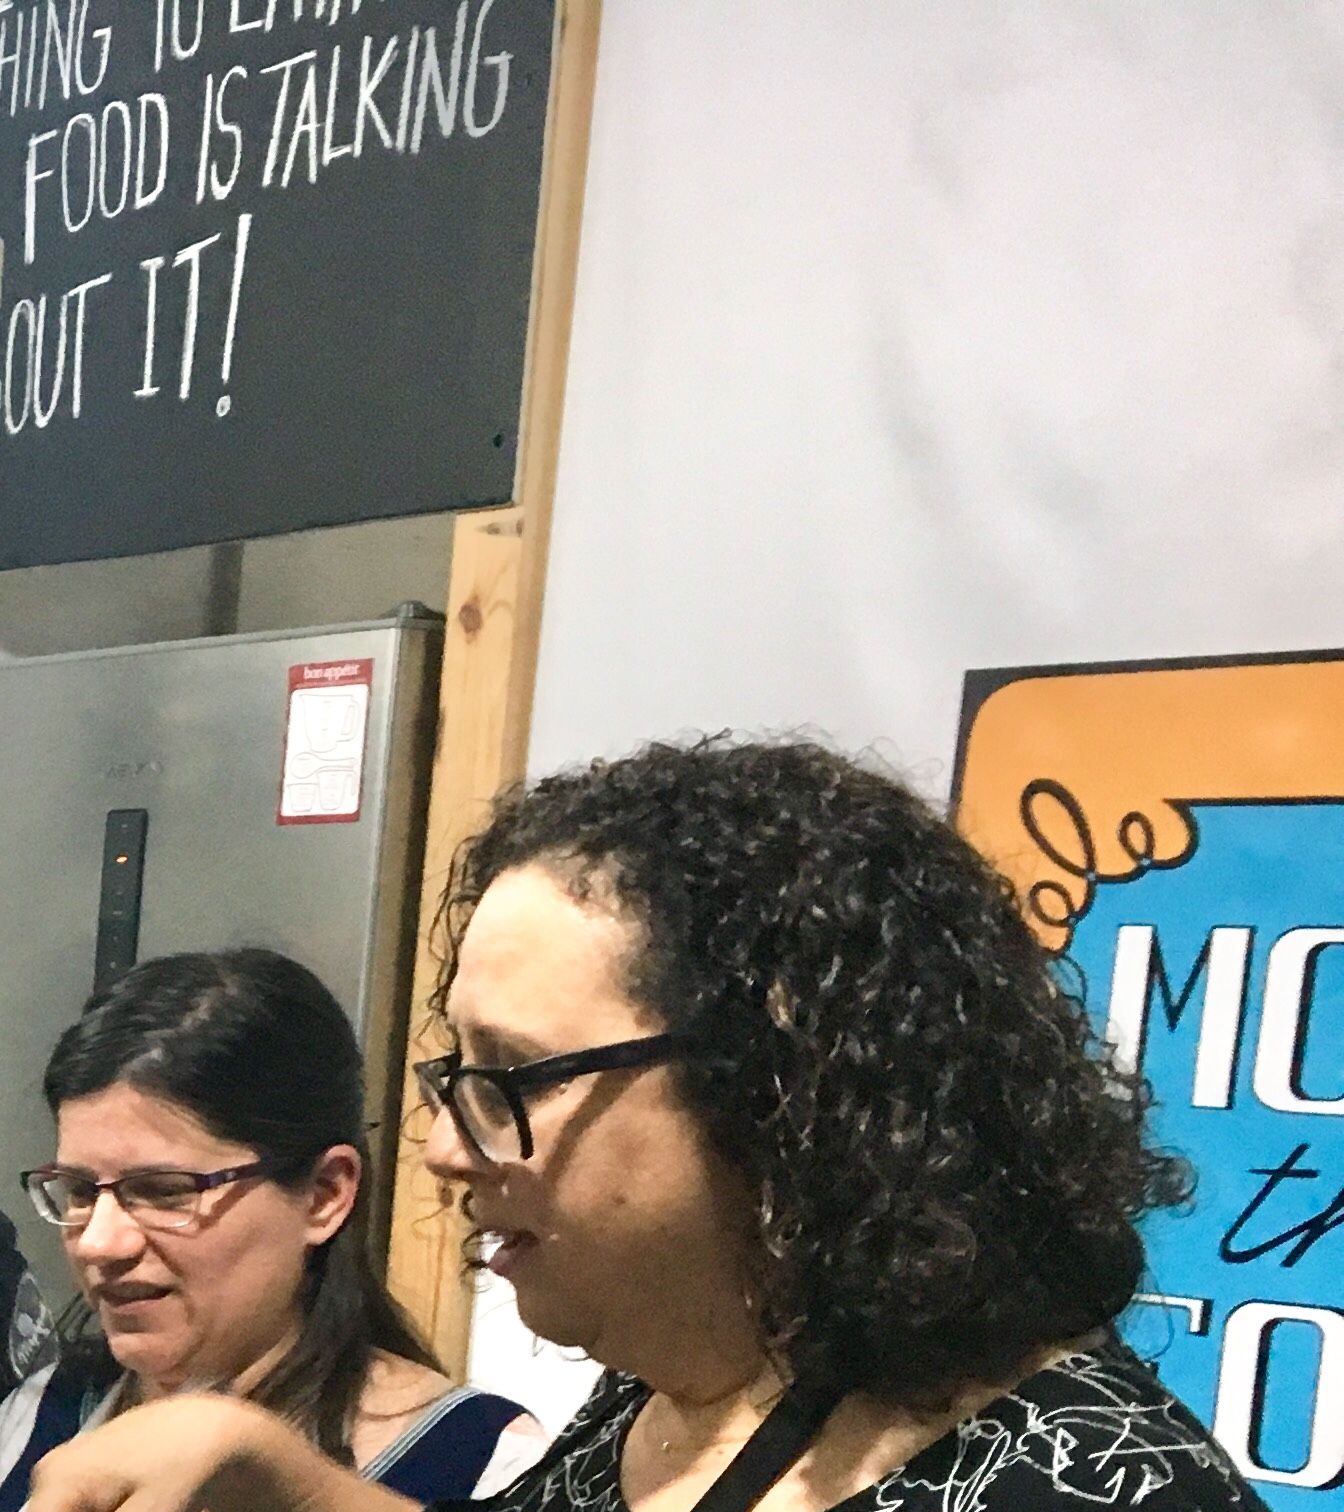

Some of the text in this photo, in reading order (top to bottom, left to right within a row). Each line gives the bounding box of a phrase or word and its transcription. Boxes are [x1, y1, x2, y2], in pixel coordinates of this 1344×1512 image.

[23, 0, 515, 264] FOOD IS TALKING
[133, 214, 253, 417] IT!
